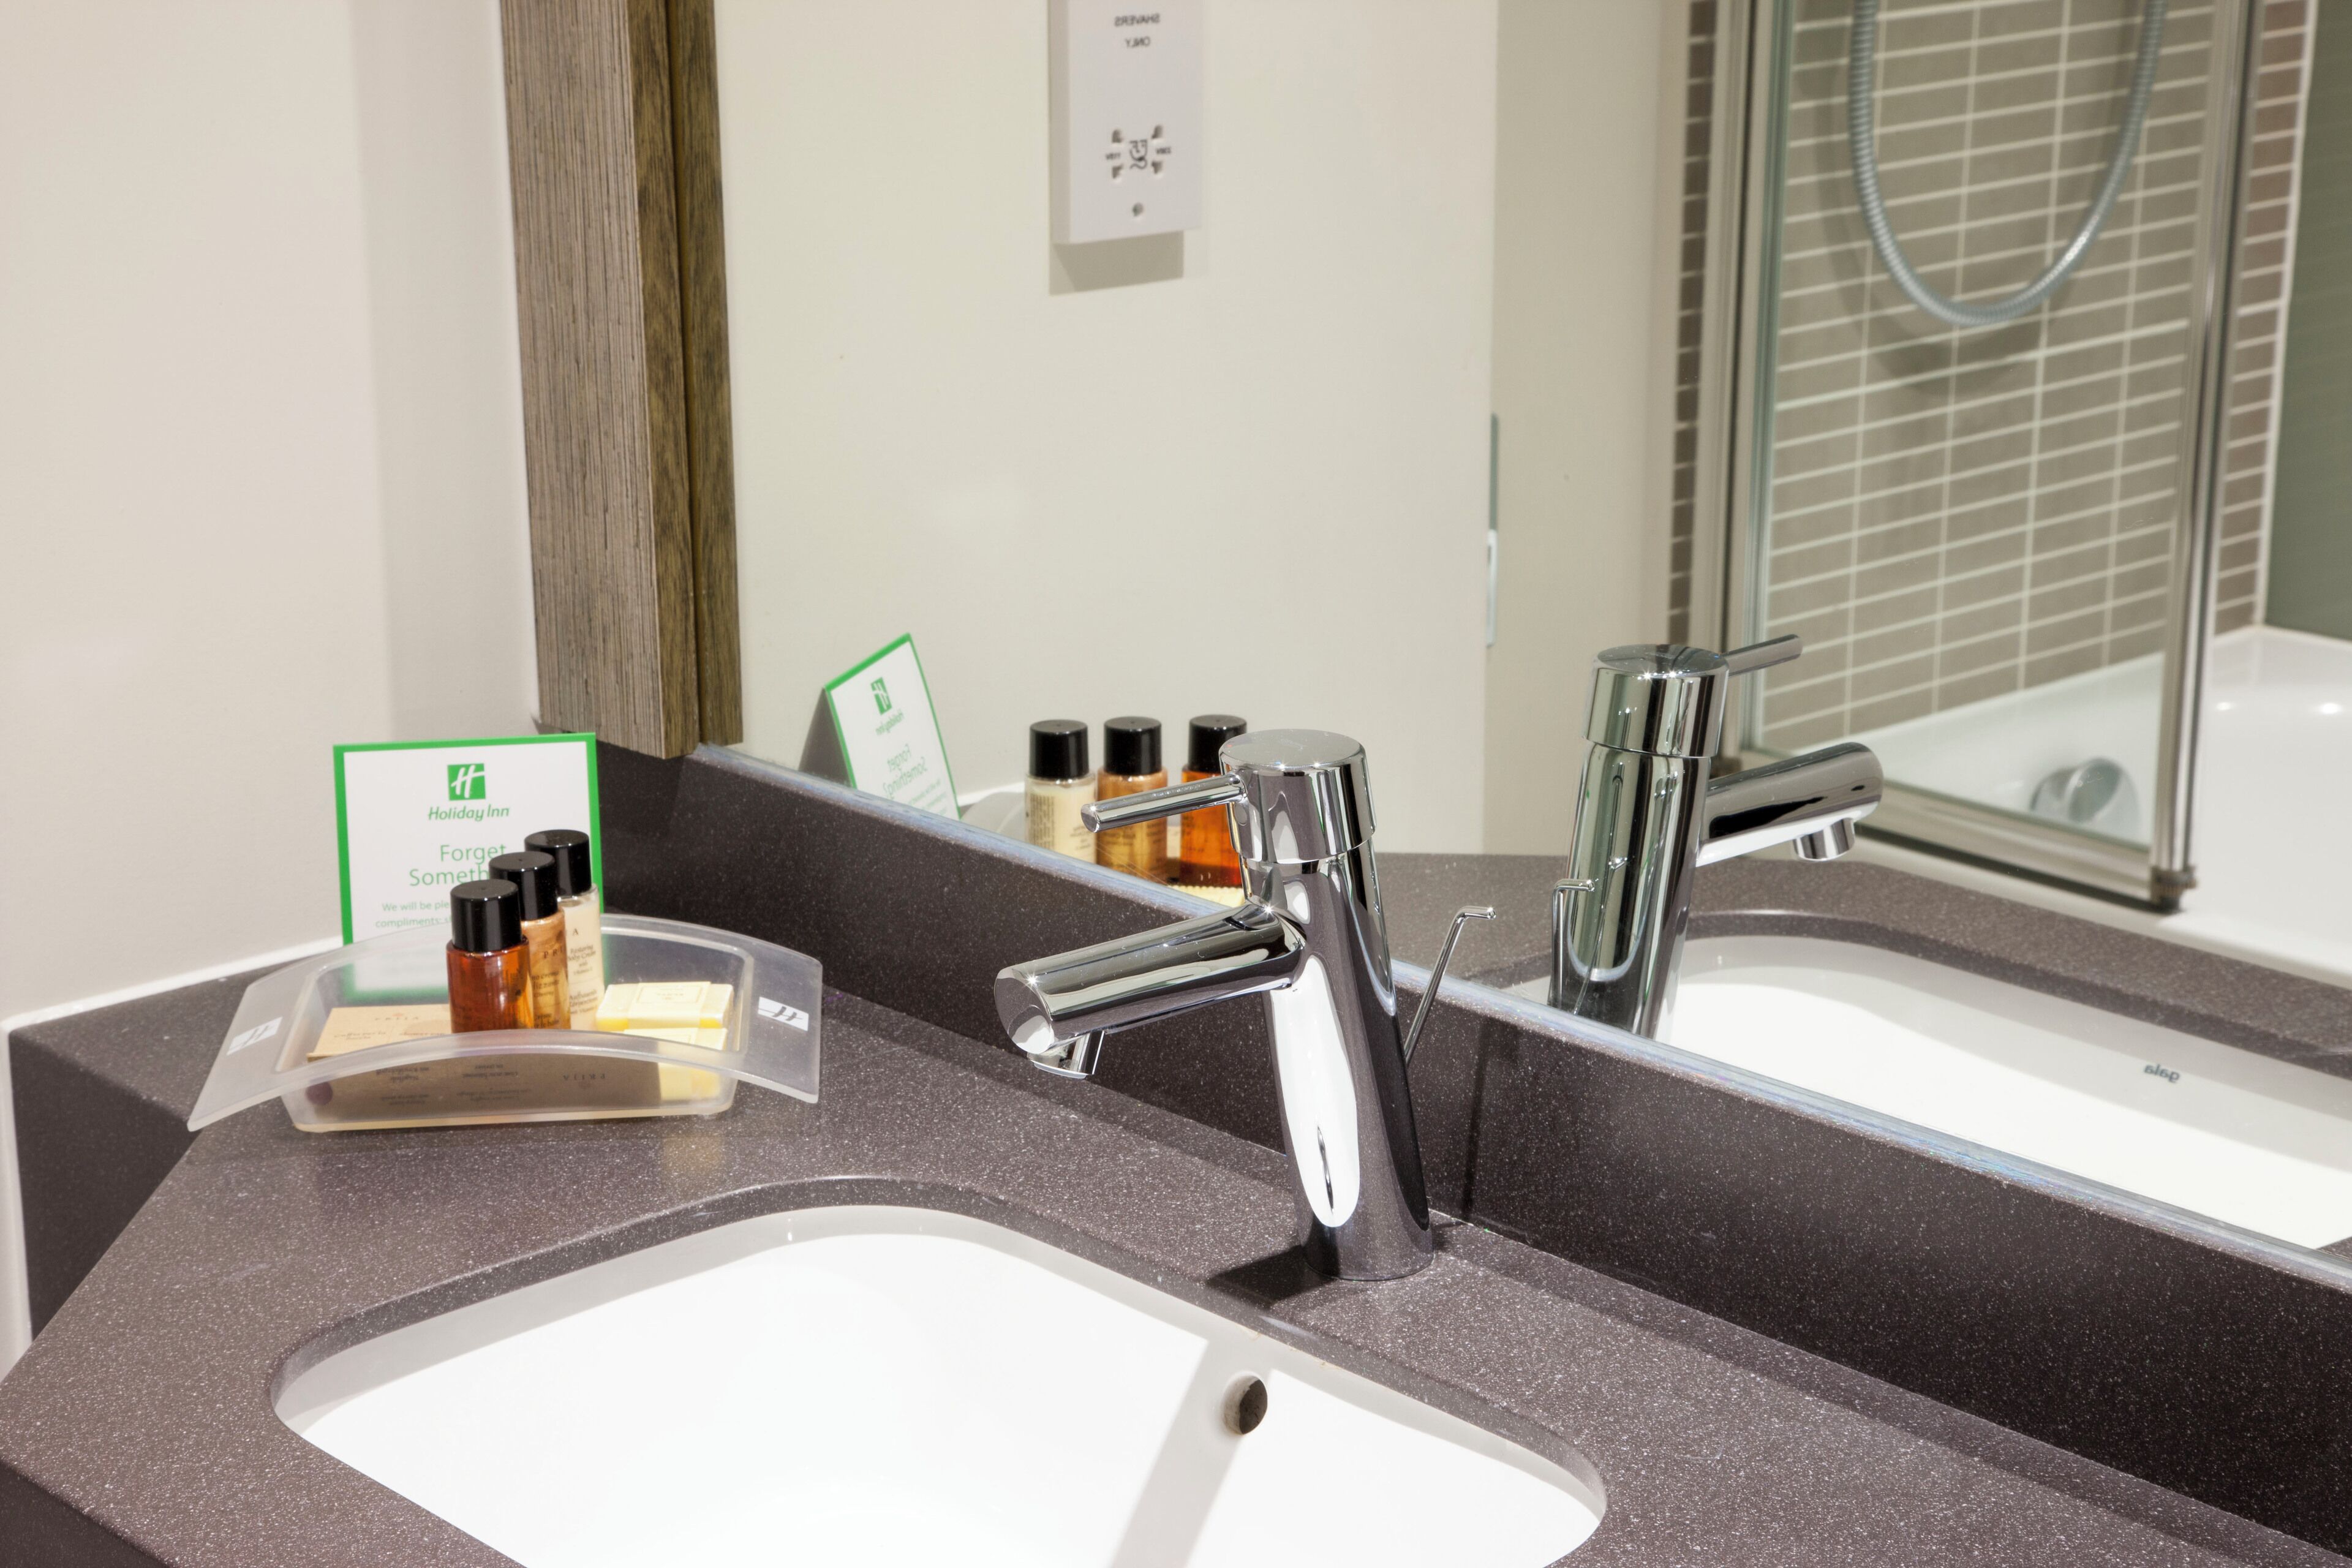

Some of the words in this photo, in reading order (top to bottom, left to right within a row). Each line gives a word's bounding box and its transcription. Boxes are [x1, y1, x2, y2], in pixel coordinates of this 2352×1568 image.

[428, 805, 484, 822] Holiday
[487, 804, 510, 818] Inn
[440, 843, 507, 865] Forget
[409, 863, 490, 886] Someth
[382, 903, 398, 911] We
[400, 902, 417, 911] will
[420, 900, 432, 910] be
[434, 900, 450, 911] ple
